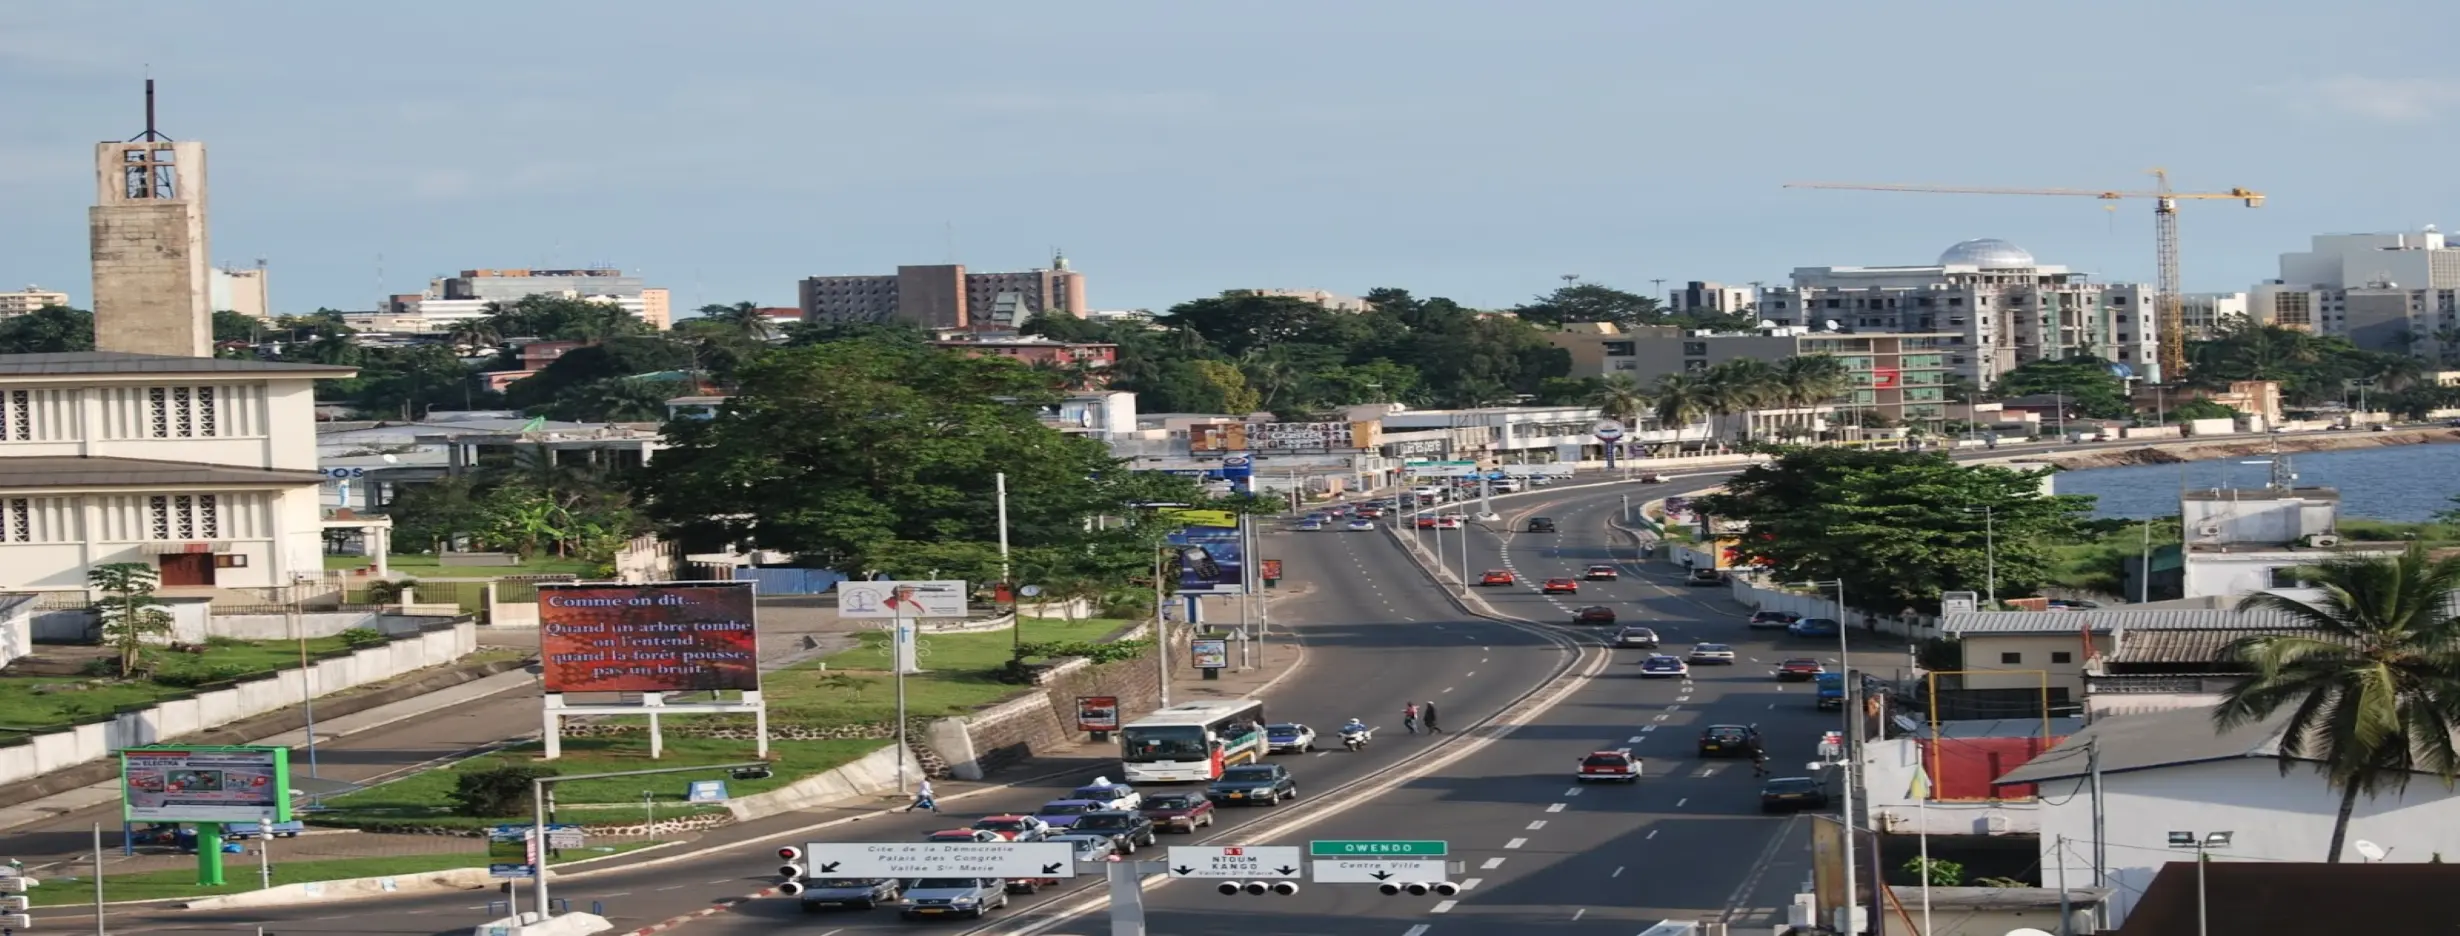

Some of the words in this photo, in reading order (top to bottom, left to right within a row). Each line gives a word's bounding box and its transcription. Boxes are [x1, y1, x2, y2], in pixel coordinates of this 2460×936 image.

[550, 596, 622, 607] Comme
[628, 596, 652, 606] on
[658, 594, 700, 606] dit...
[546, 622, 605, 636] Quand
[612, 624, 634, 633] un
[638, 622, 688, 632] arbre
[693, 620, 752, 632] tombe
[592, 638, 616, 647] on
[550, 652, 605, 664] quand
[612, 651, 627, 661] la
[633, 650, 676, 660] forêt
[591, 666, 624, 678] pas
[628, 666, 651, 675] un
[657, 664, 708, 674] bruit.
[1345, 844, 1412, 852] OWENDO
